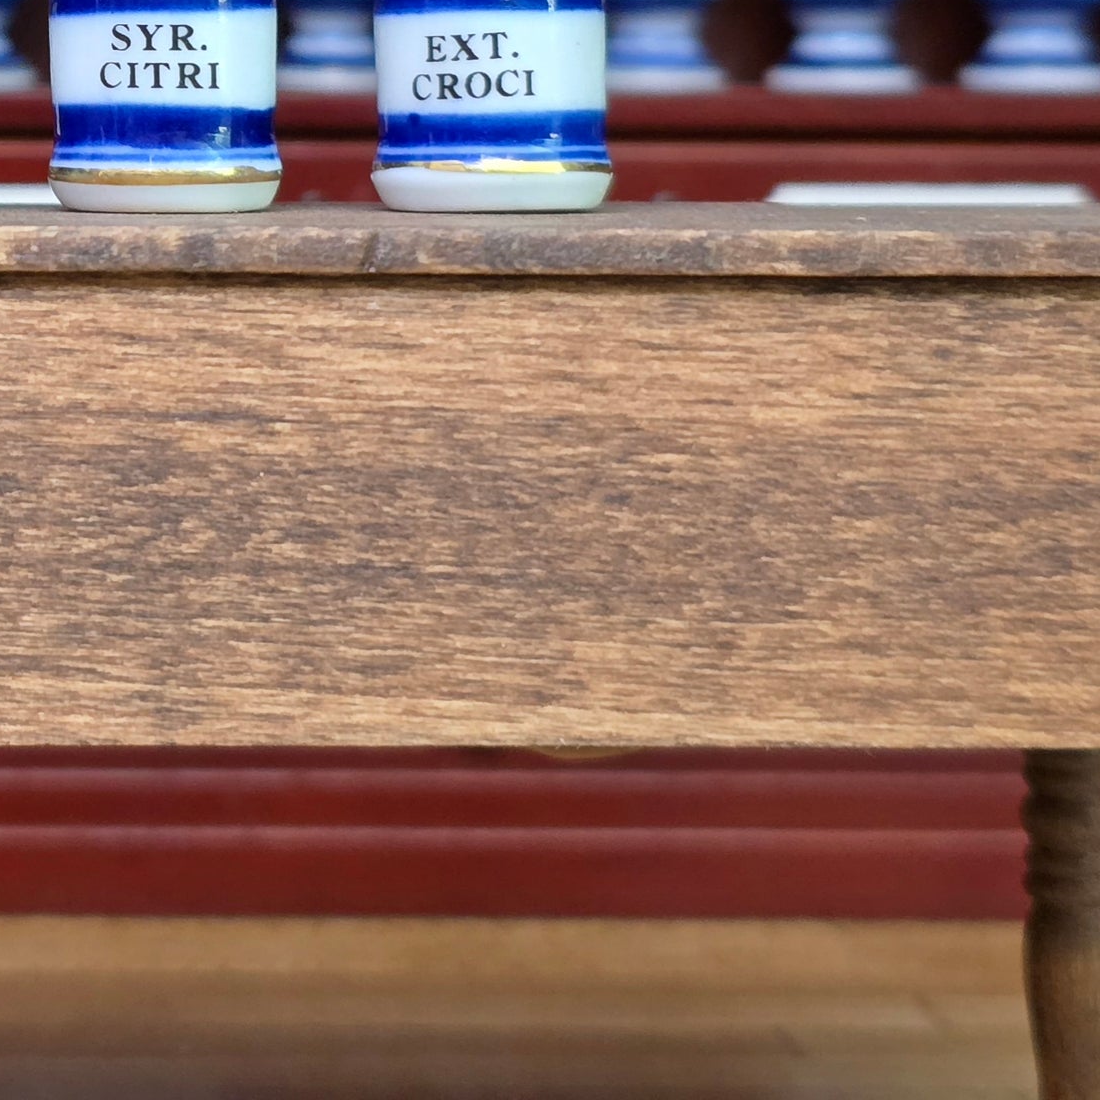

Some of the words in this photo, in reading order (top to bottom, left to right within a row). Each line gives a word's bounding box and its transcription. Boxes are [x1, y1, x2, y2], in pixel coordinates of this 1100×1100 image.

[111, 23, 207, 51] SYR.
[426, 32, 519, 63] EXT.
[99, 62, 219, 90] CITRI
[412, 70, 535, 101] CROCI
